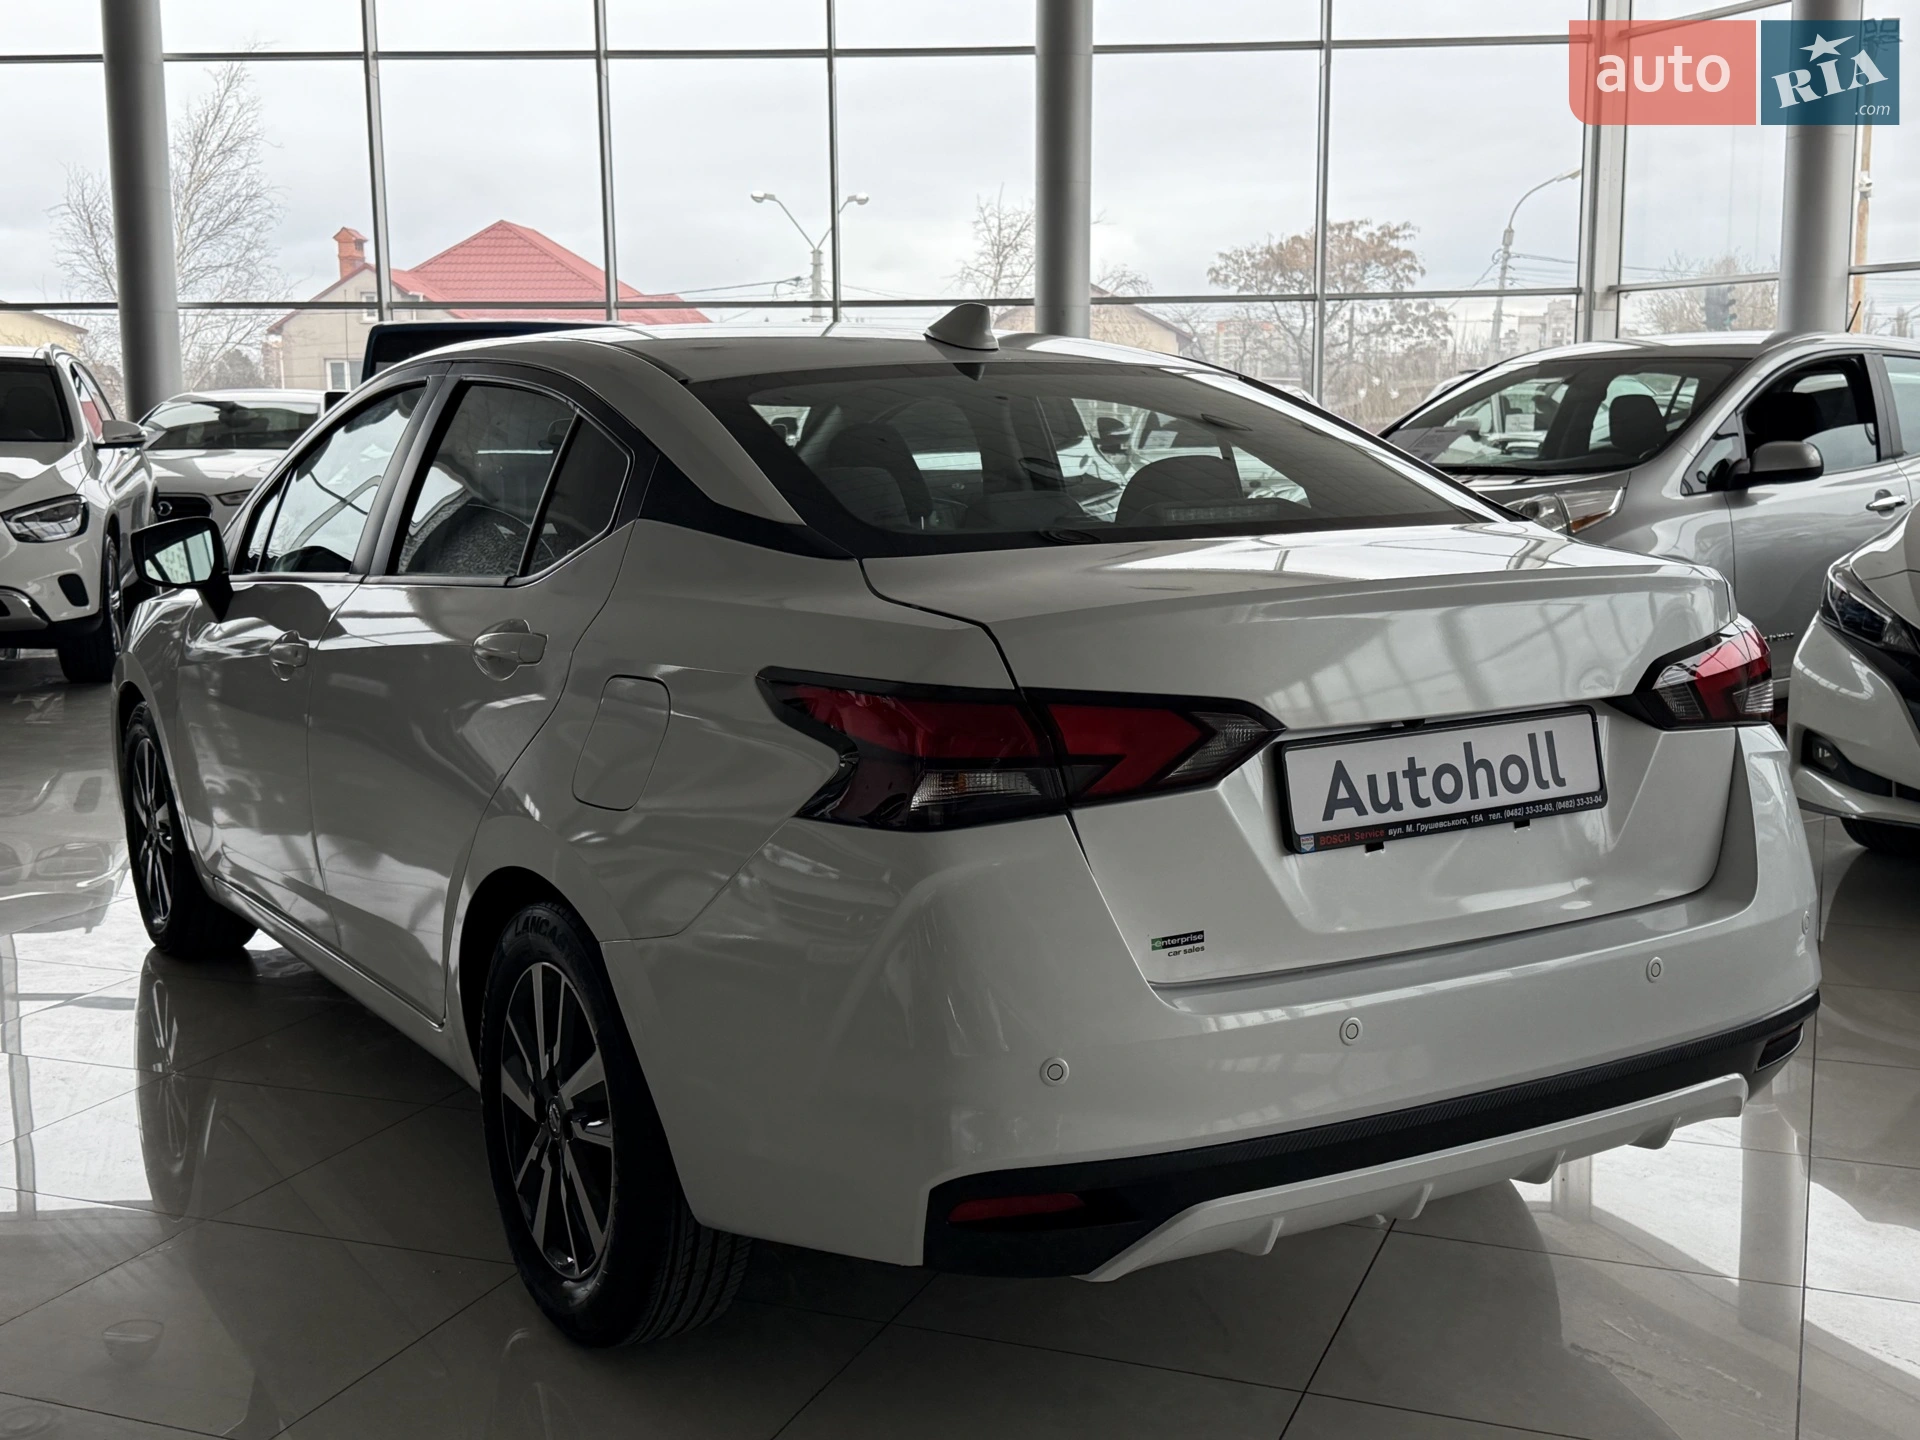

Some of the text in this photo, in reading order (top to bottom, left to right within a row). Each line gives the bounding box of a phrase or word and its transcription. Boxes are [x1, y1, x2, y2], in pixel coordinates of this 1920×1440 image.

[1321, 730, 1567, 822] Autoholl
[1388, 824, 1404, 837] вул.
[1416, 818, 1469, 832] Грушевського,
[1489, 812, 1503, 821] тел.
[1504, 806, 1524, 819] (0482)
[1525, 804, 1555, 815] 33-33-03,
[1556, 800, 1575, 811] (0482)
[1577, 796, 1602, 806] 33-33-04
[1319, 832, 1351, 846] BOSCH
[1354, 828, 1385, 840] Service
[1152, 934, 1203, 947] enterprise
[1167, 945, 1205, 957] car sales
